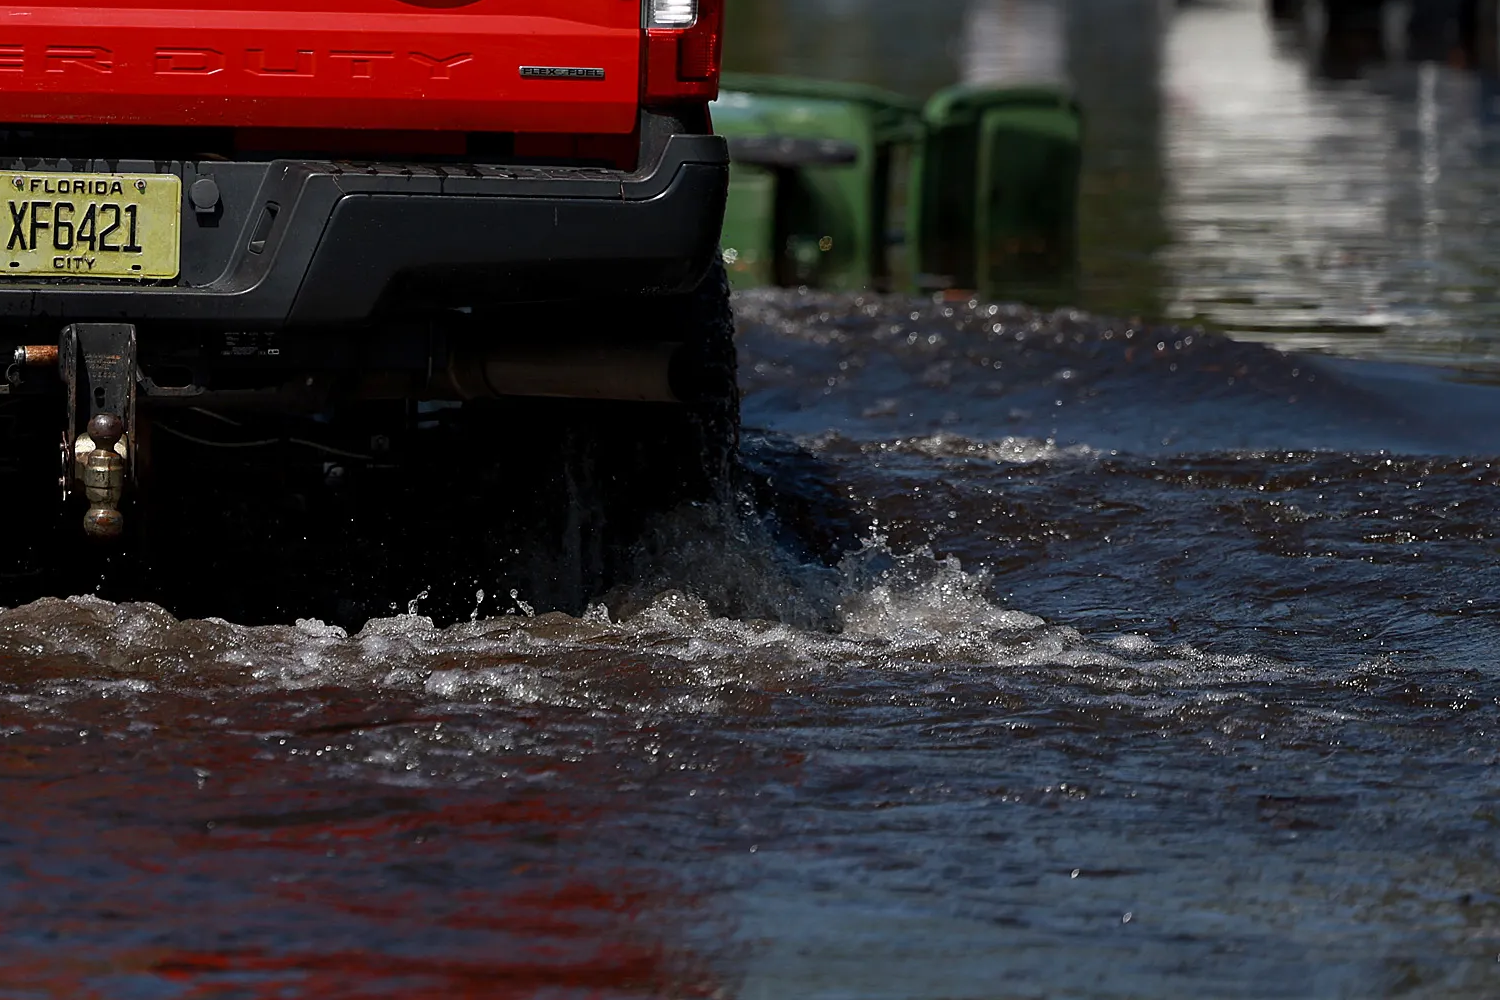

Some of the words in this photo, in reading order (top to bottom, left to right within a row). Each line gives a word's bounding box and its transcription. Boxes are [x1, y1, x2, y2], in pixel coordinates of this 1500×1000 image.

[154, 46, 474, 80] DUTY
[522, 67, 557, 76] FLEX
[567, 68, 604, 77] FUEL
[29, 178, 123, 196] FLORIDA
[6, 201, 142, 254] XF6421
[53, 256, 96, 270] CITY
